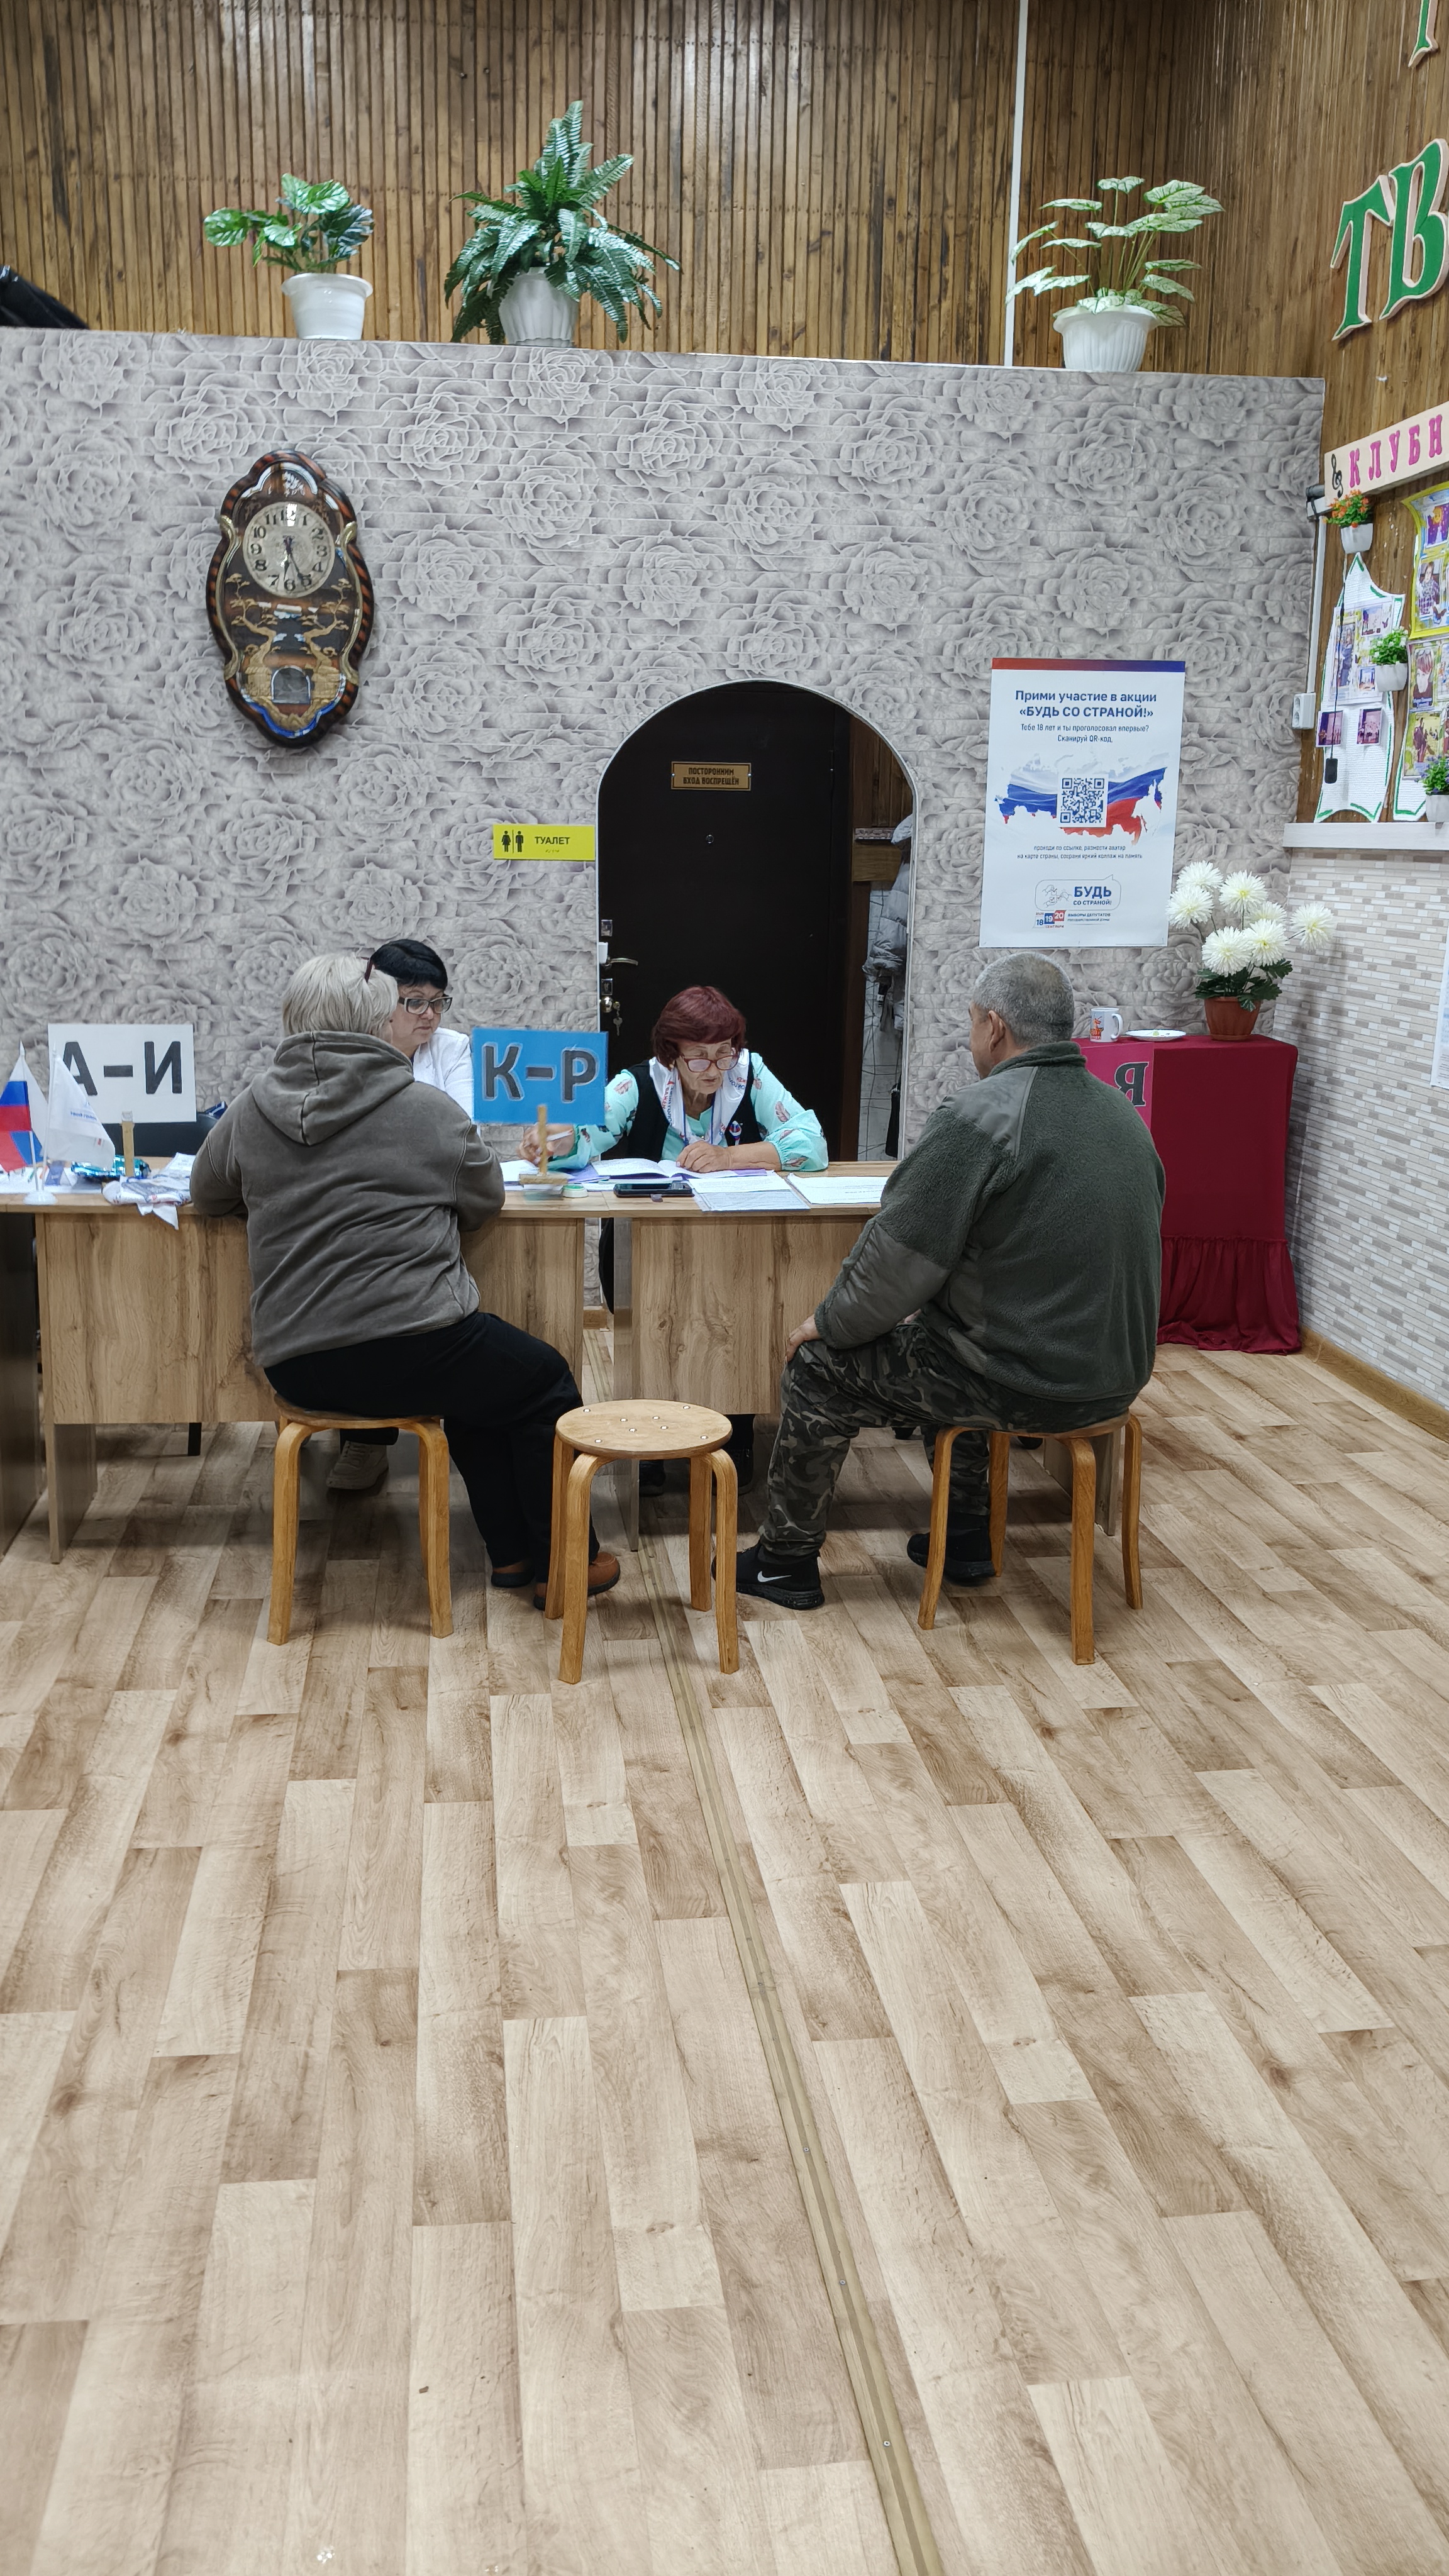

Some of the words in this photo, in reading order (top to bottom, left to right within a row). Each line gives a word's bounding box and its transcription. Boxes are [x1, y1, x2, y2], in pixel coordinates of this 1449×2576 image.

[1349, 414, 1443, 488] КЛУБН
[265, 513, 277, 525] 11
[253, 525, 267, 538] 10
[311, 528, 325, 540] 2
[250, 543, 262, 555] 9
[316, 545, 328, 557] 3
[255, 559, 267, 572] 8
[311, 561, 323, 573] 4
[268, 574, 279, 587] 7
[284, 578, 296, 592] 6
[1015, 690, 1056, 703] Прими
[1058, 692, 1108, 704] участие
[1110, 694, 1118, 702] в
[1120, 694, 1157, 704] акции
[1019, 706, 1060, 718] «БУДЬ
[1062, 706, 1080, 717] СО
[1083, 704, 1153, 718] СТРАНОЙ!»
[1118, 724, 1149, 733] впервые?
[1058, 734, 1087, 743] Сканируй
[688, 767, 735, 776] ПОСТОРОННИМ
[683, 777, 700, 785] ВХОД
[535, 836, 570, 845] ТУАЛЕТ
[1074, 886, 1112, 899] БУДЬ
